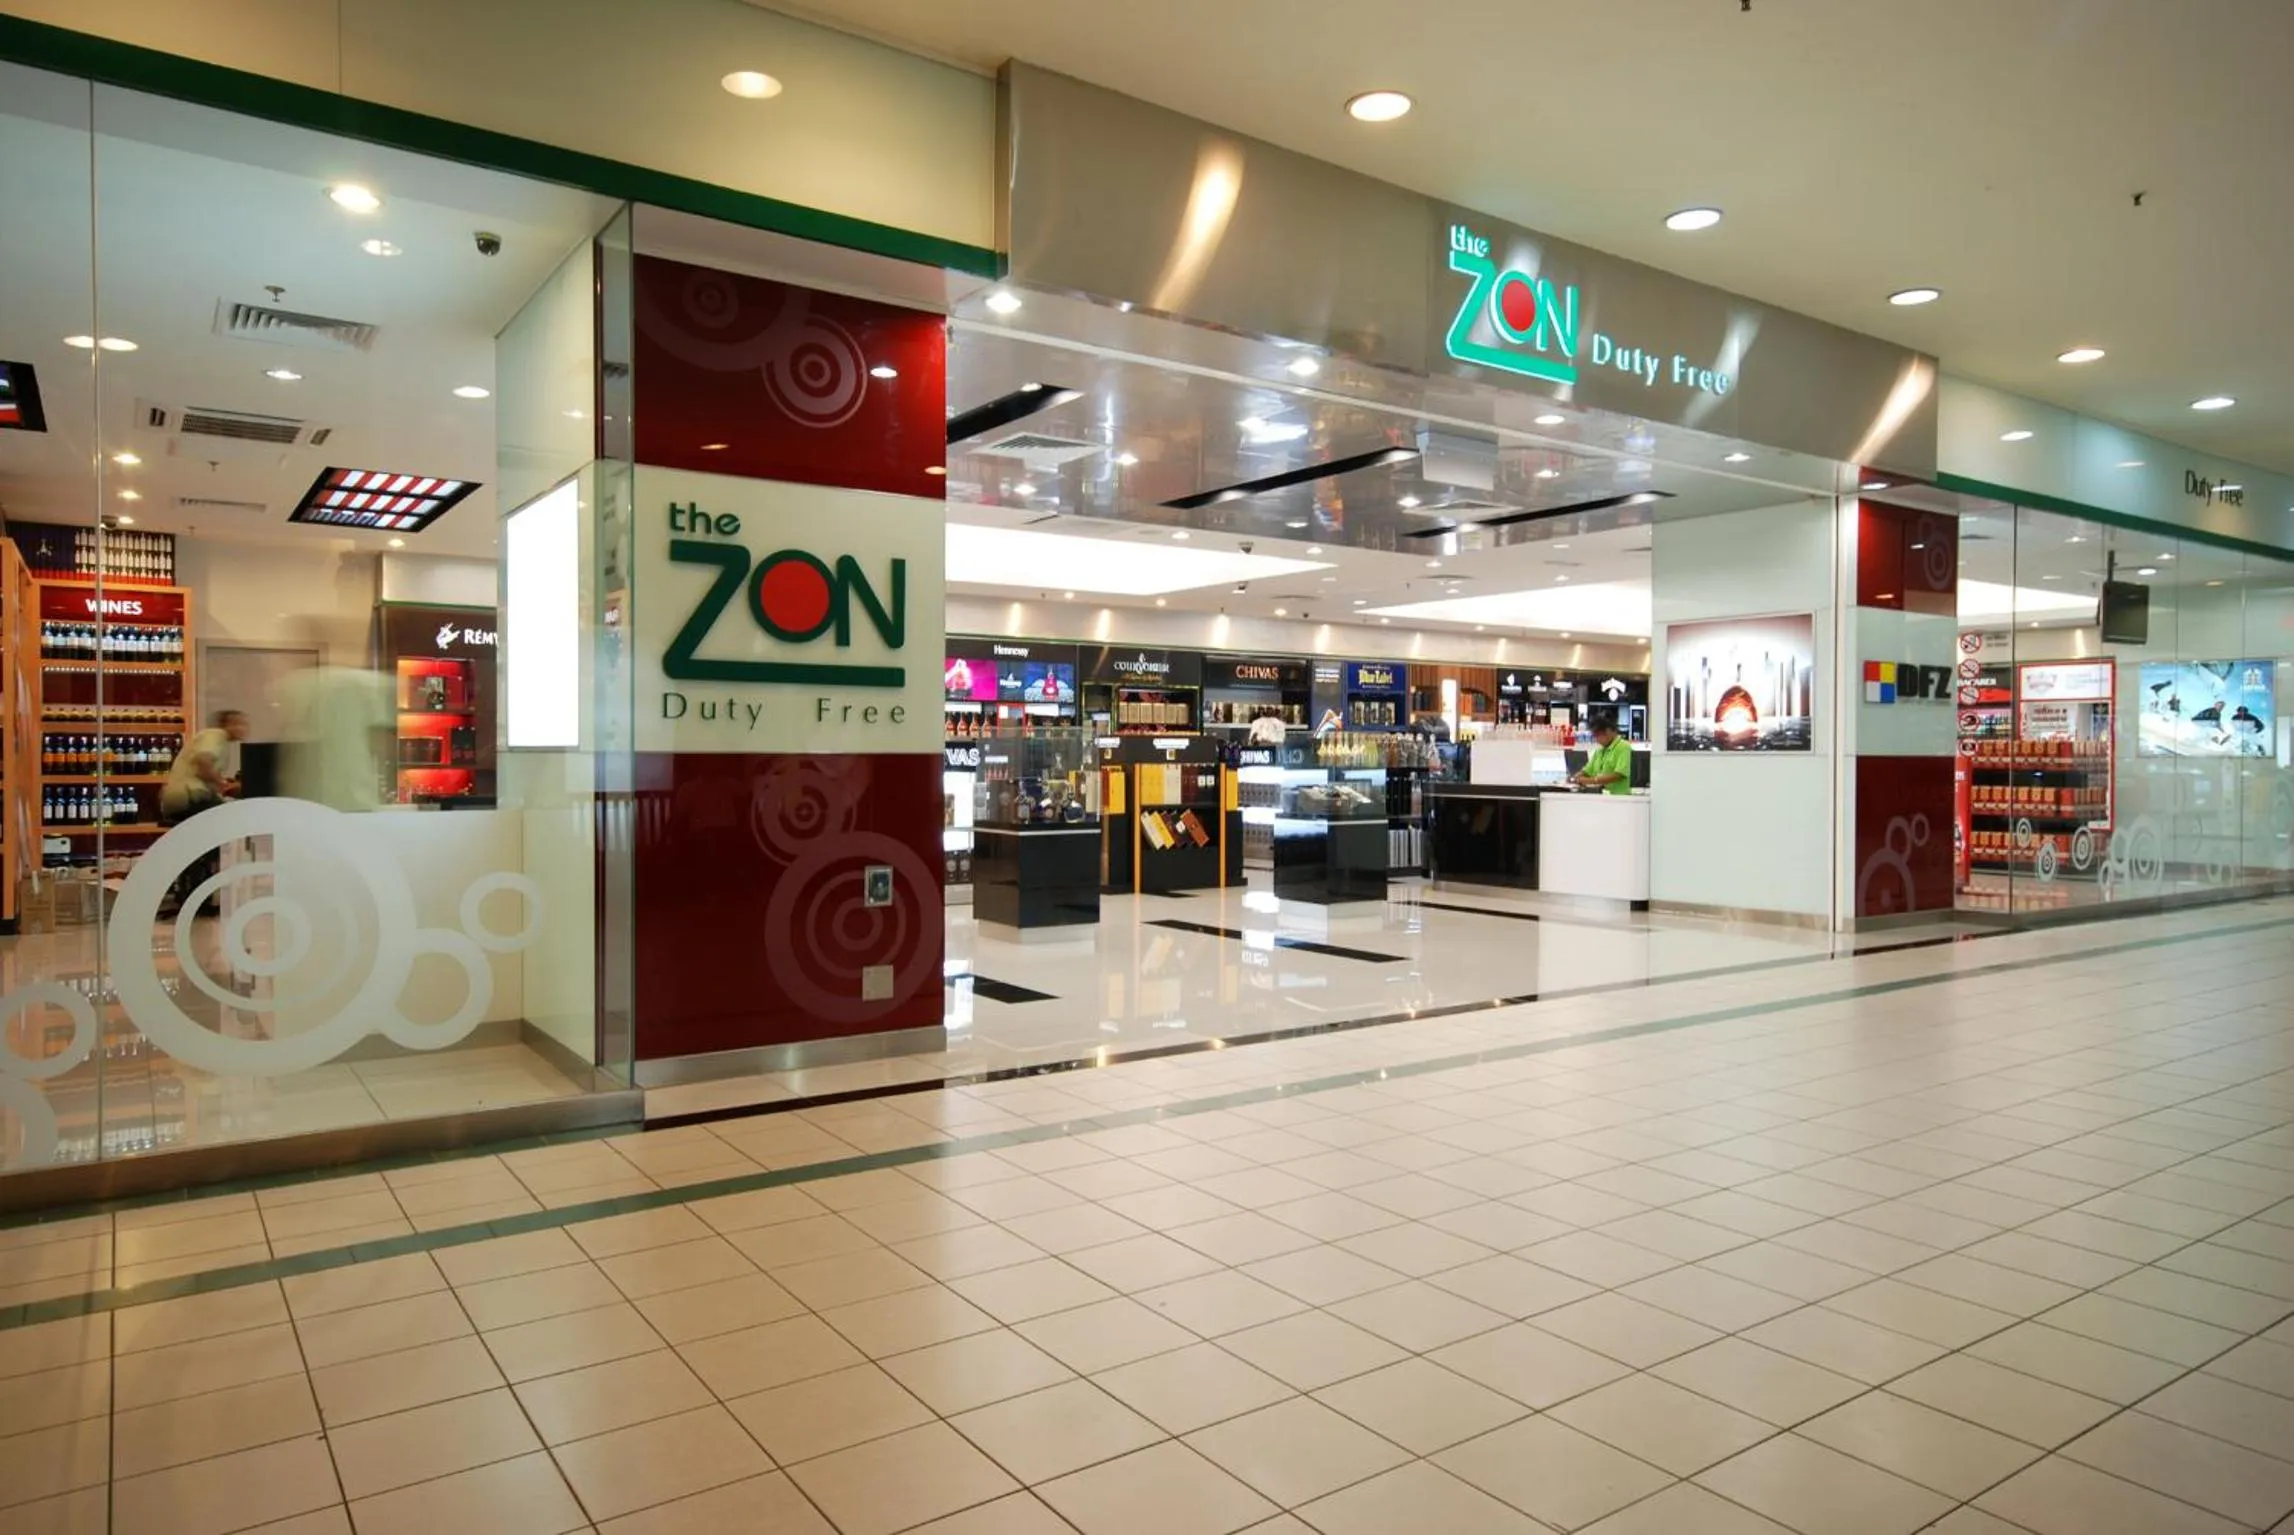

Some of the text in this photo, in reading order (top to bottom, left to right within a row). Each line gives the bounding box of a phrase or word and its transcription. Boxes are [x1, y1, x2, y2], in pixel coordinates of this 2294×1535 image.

[1450, 224, 1489, 258] the
[1446, 250, 1579, 386] ZON
[1591, 333, 1731, 395] Duty Free
[2185, 470, 2244, 508] Duty Free
[669, 501, 741, 536] the
[84, 598, 144, 616] WINES
[661, 538, 906, 688] ZON
[1235, 664, 1280, 681] CHIVAS
[1896, 661, 1953, 699] DFZ
[661, 691, 906, 731] Duty Free
